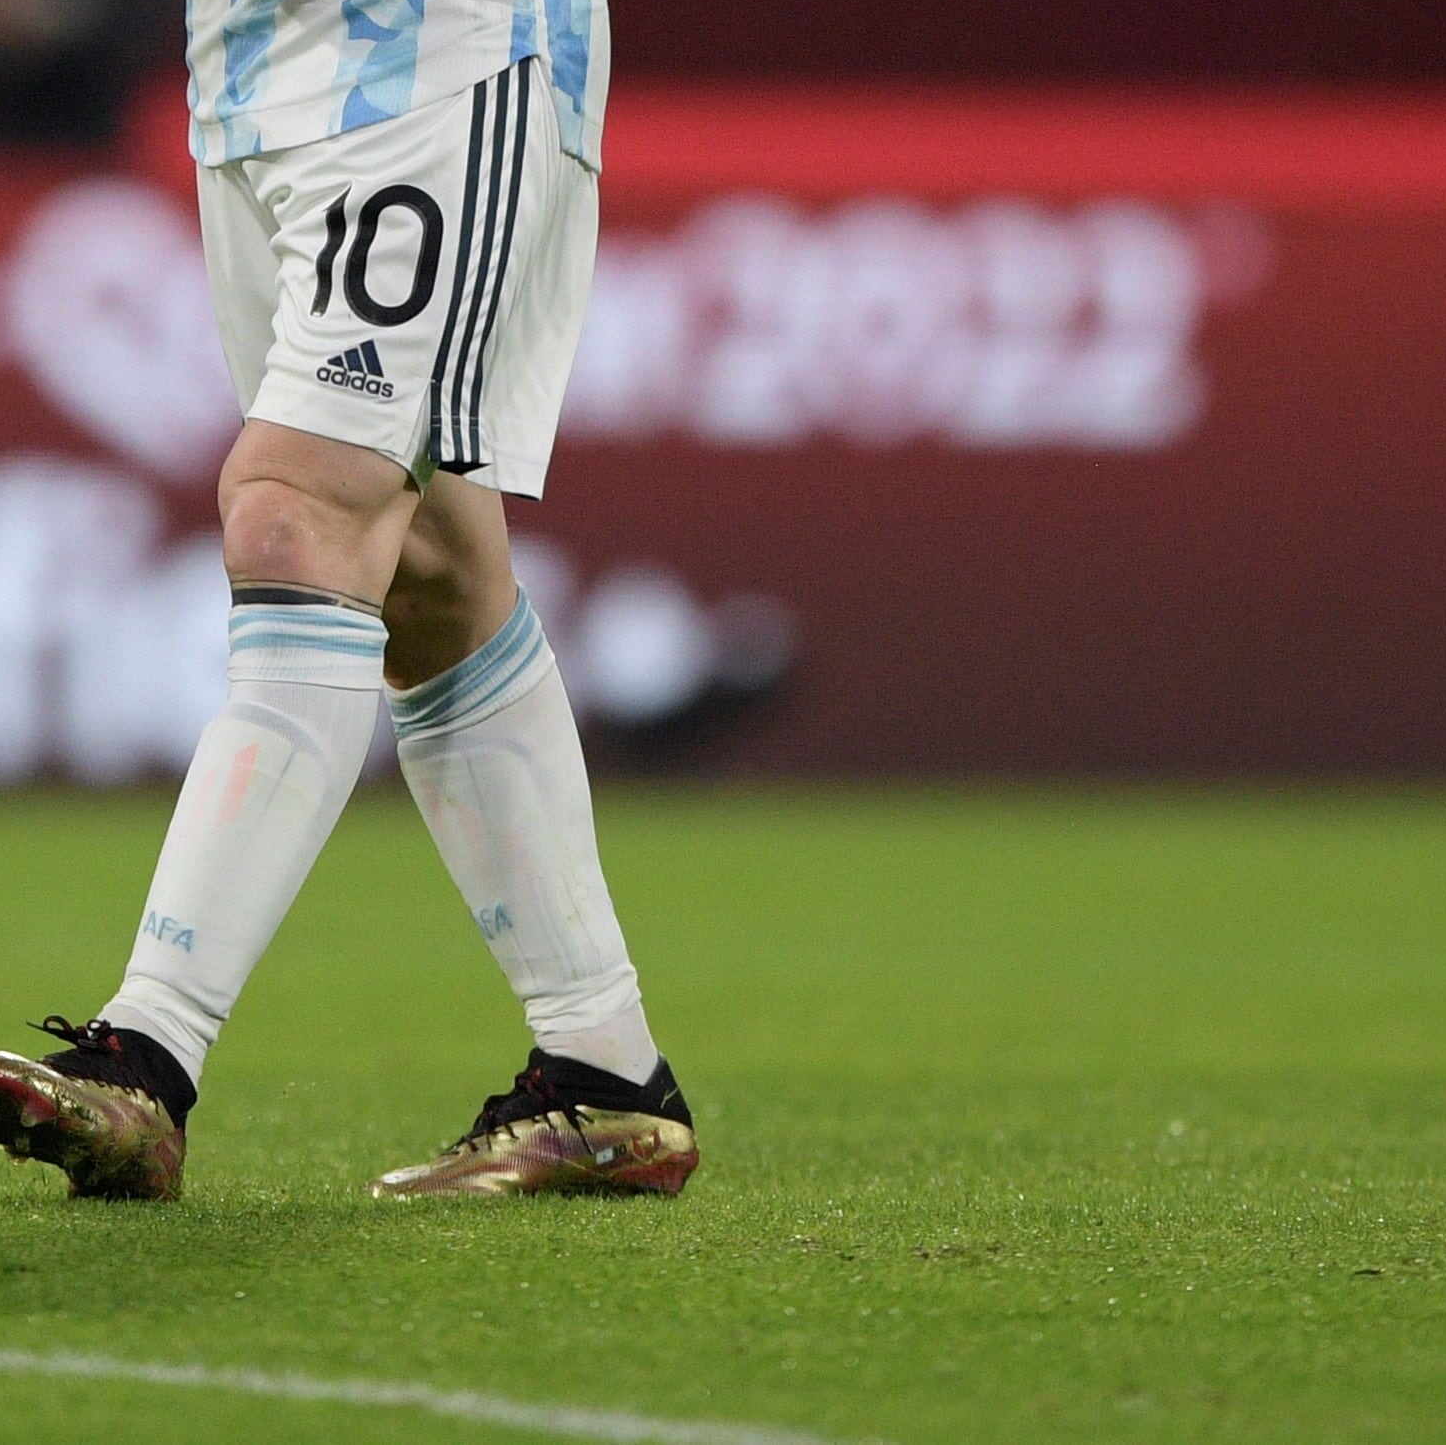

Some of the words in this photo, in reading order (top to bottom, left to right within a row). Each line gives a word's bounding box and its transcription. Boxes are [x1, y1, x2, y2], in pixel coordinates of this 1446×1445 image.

[310, 184, 444, 328] 10
[316, 366, 394, 398] adidas
[143, 910, 195, 953] AFA
[472, 904, 513, 940] FA
